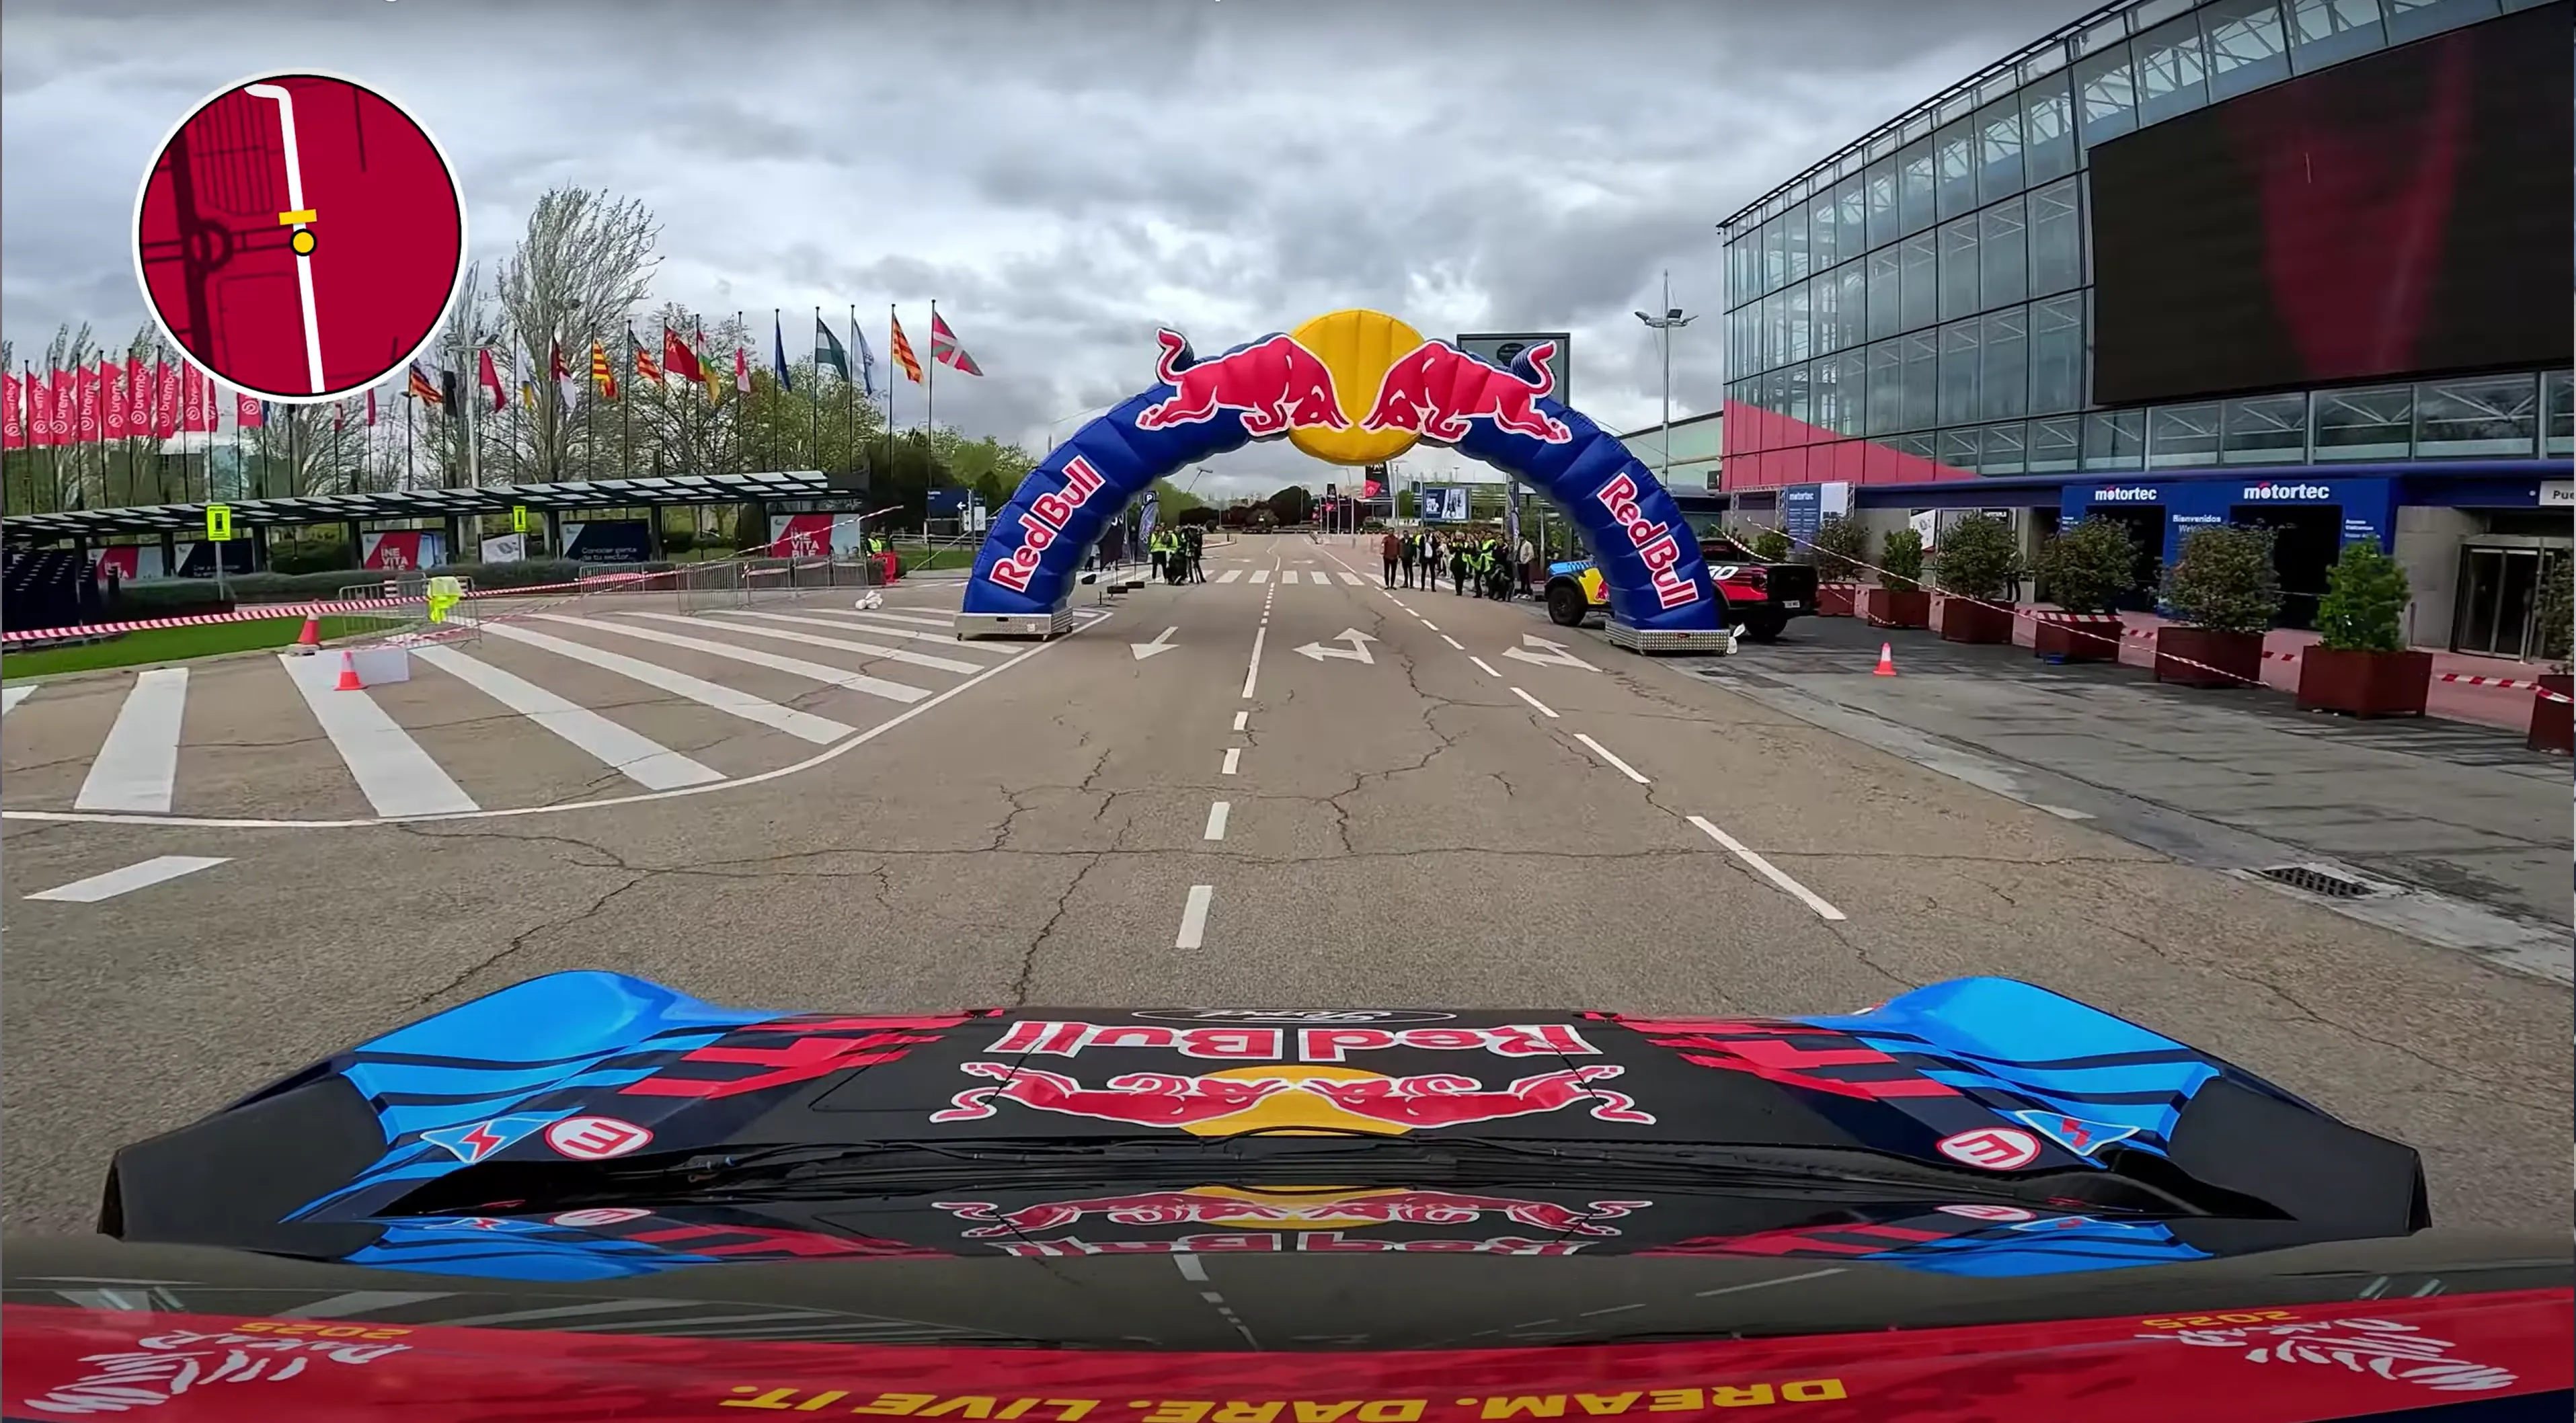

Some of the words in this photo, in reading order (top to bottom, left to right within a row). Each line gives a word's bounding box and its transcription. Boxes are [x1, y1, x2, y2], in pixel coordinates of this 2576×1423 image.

[134, 368, 147, 409] brembo
[2095, 485, 2157, 500] motortec
[2244, 482, 2330, 499] motortec
[988, 513, 1058, 593] Red
[1029, 454, 1106, 530] Bull
[2173, 514, 2221, 522] Bienvenidos
[381, 548, 400, 557] INE
[791, 540, 819, 550] VITA
[1596, 472, 1669, 548] Red
[1639, 534, 1699, 610] Bull
[383, 557, 409, 565] VITA
[982, 1020, 1284, 1060] Bull
[1298, 1023, 1606, 1062] Red
[232, 1322, 415, 1339] 2025
[2142, 1310, 2302, 1330] 2025
[719, 1385, 851, 1411] IT.
[851, 1392, 1102, 1422] LIVE
[1455, 1378, 1847, 1420] DREAM.
[1128, 1399, 1428, 1423] DARE.
